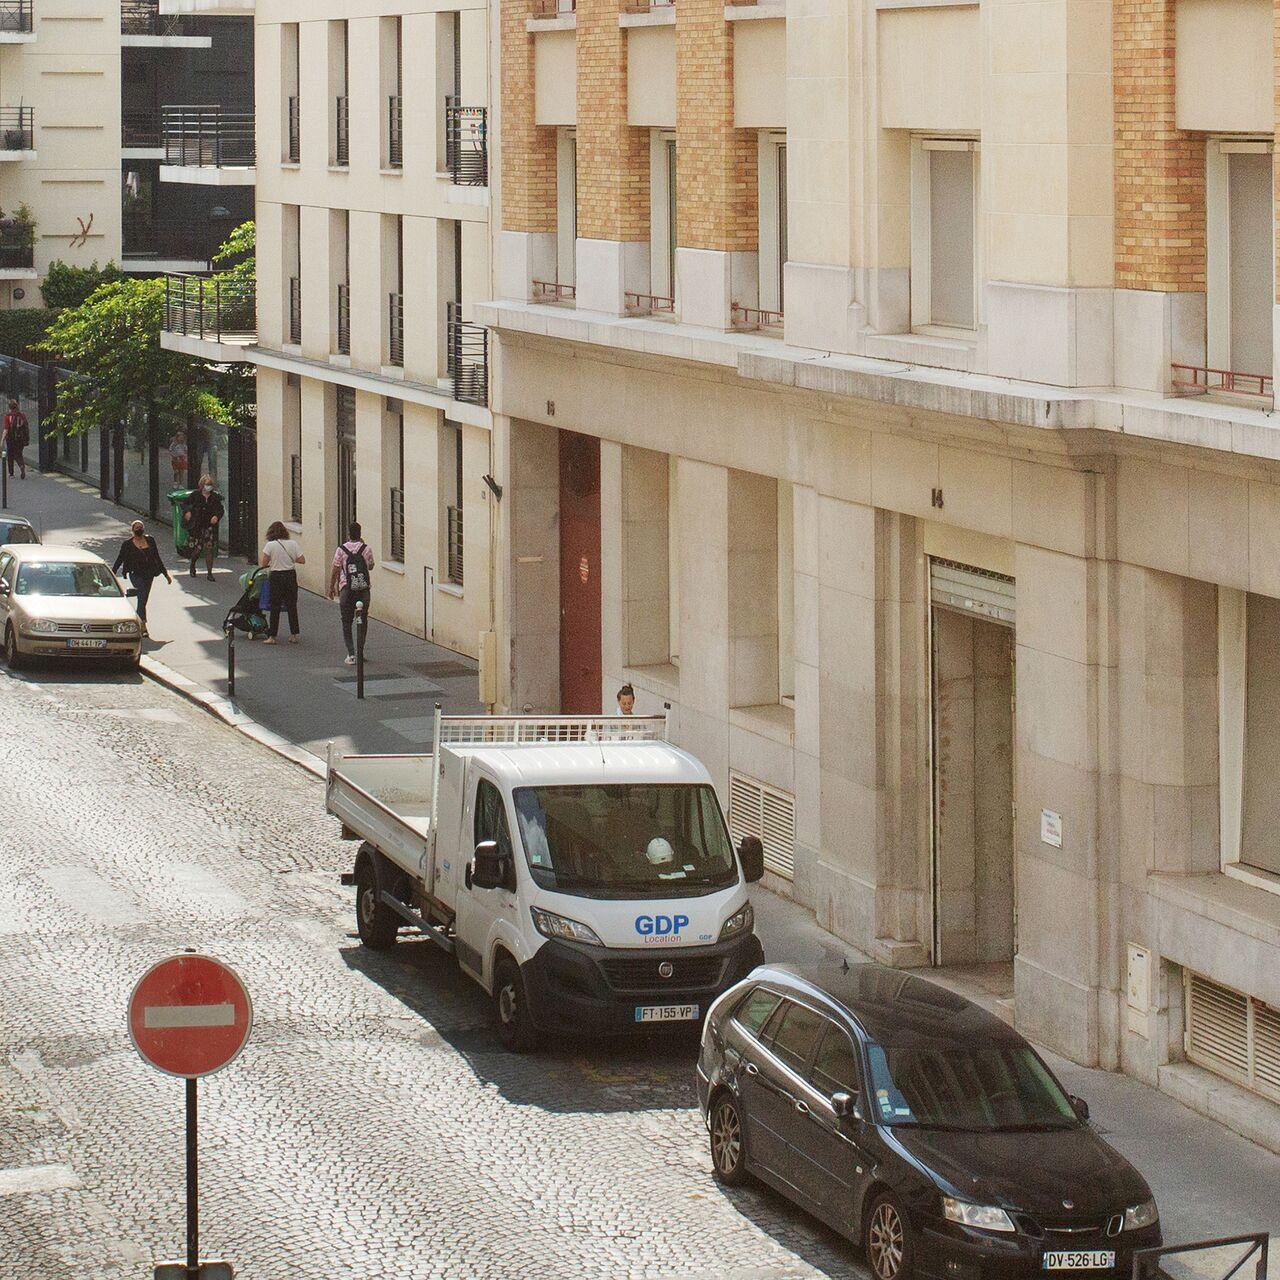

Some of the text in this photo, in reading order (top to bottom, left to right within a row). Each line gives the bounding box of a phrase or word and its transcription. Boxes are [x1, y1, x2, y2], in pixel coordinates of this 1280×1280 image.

[635, 915, 689, 935] GDP
[644, 935, 682, 943] Location
[642, 1006, 692, 1019] FT-155-VP
[1048, 1252, 1108, 1267] DV-526-LG
